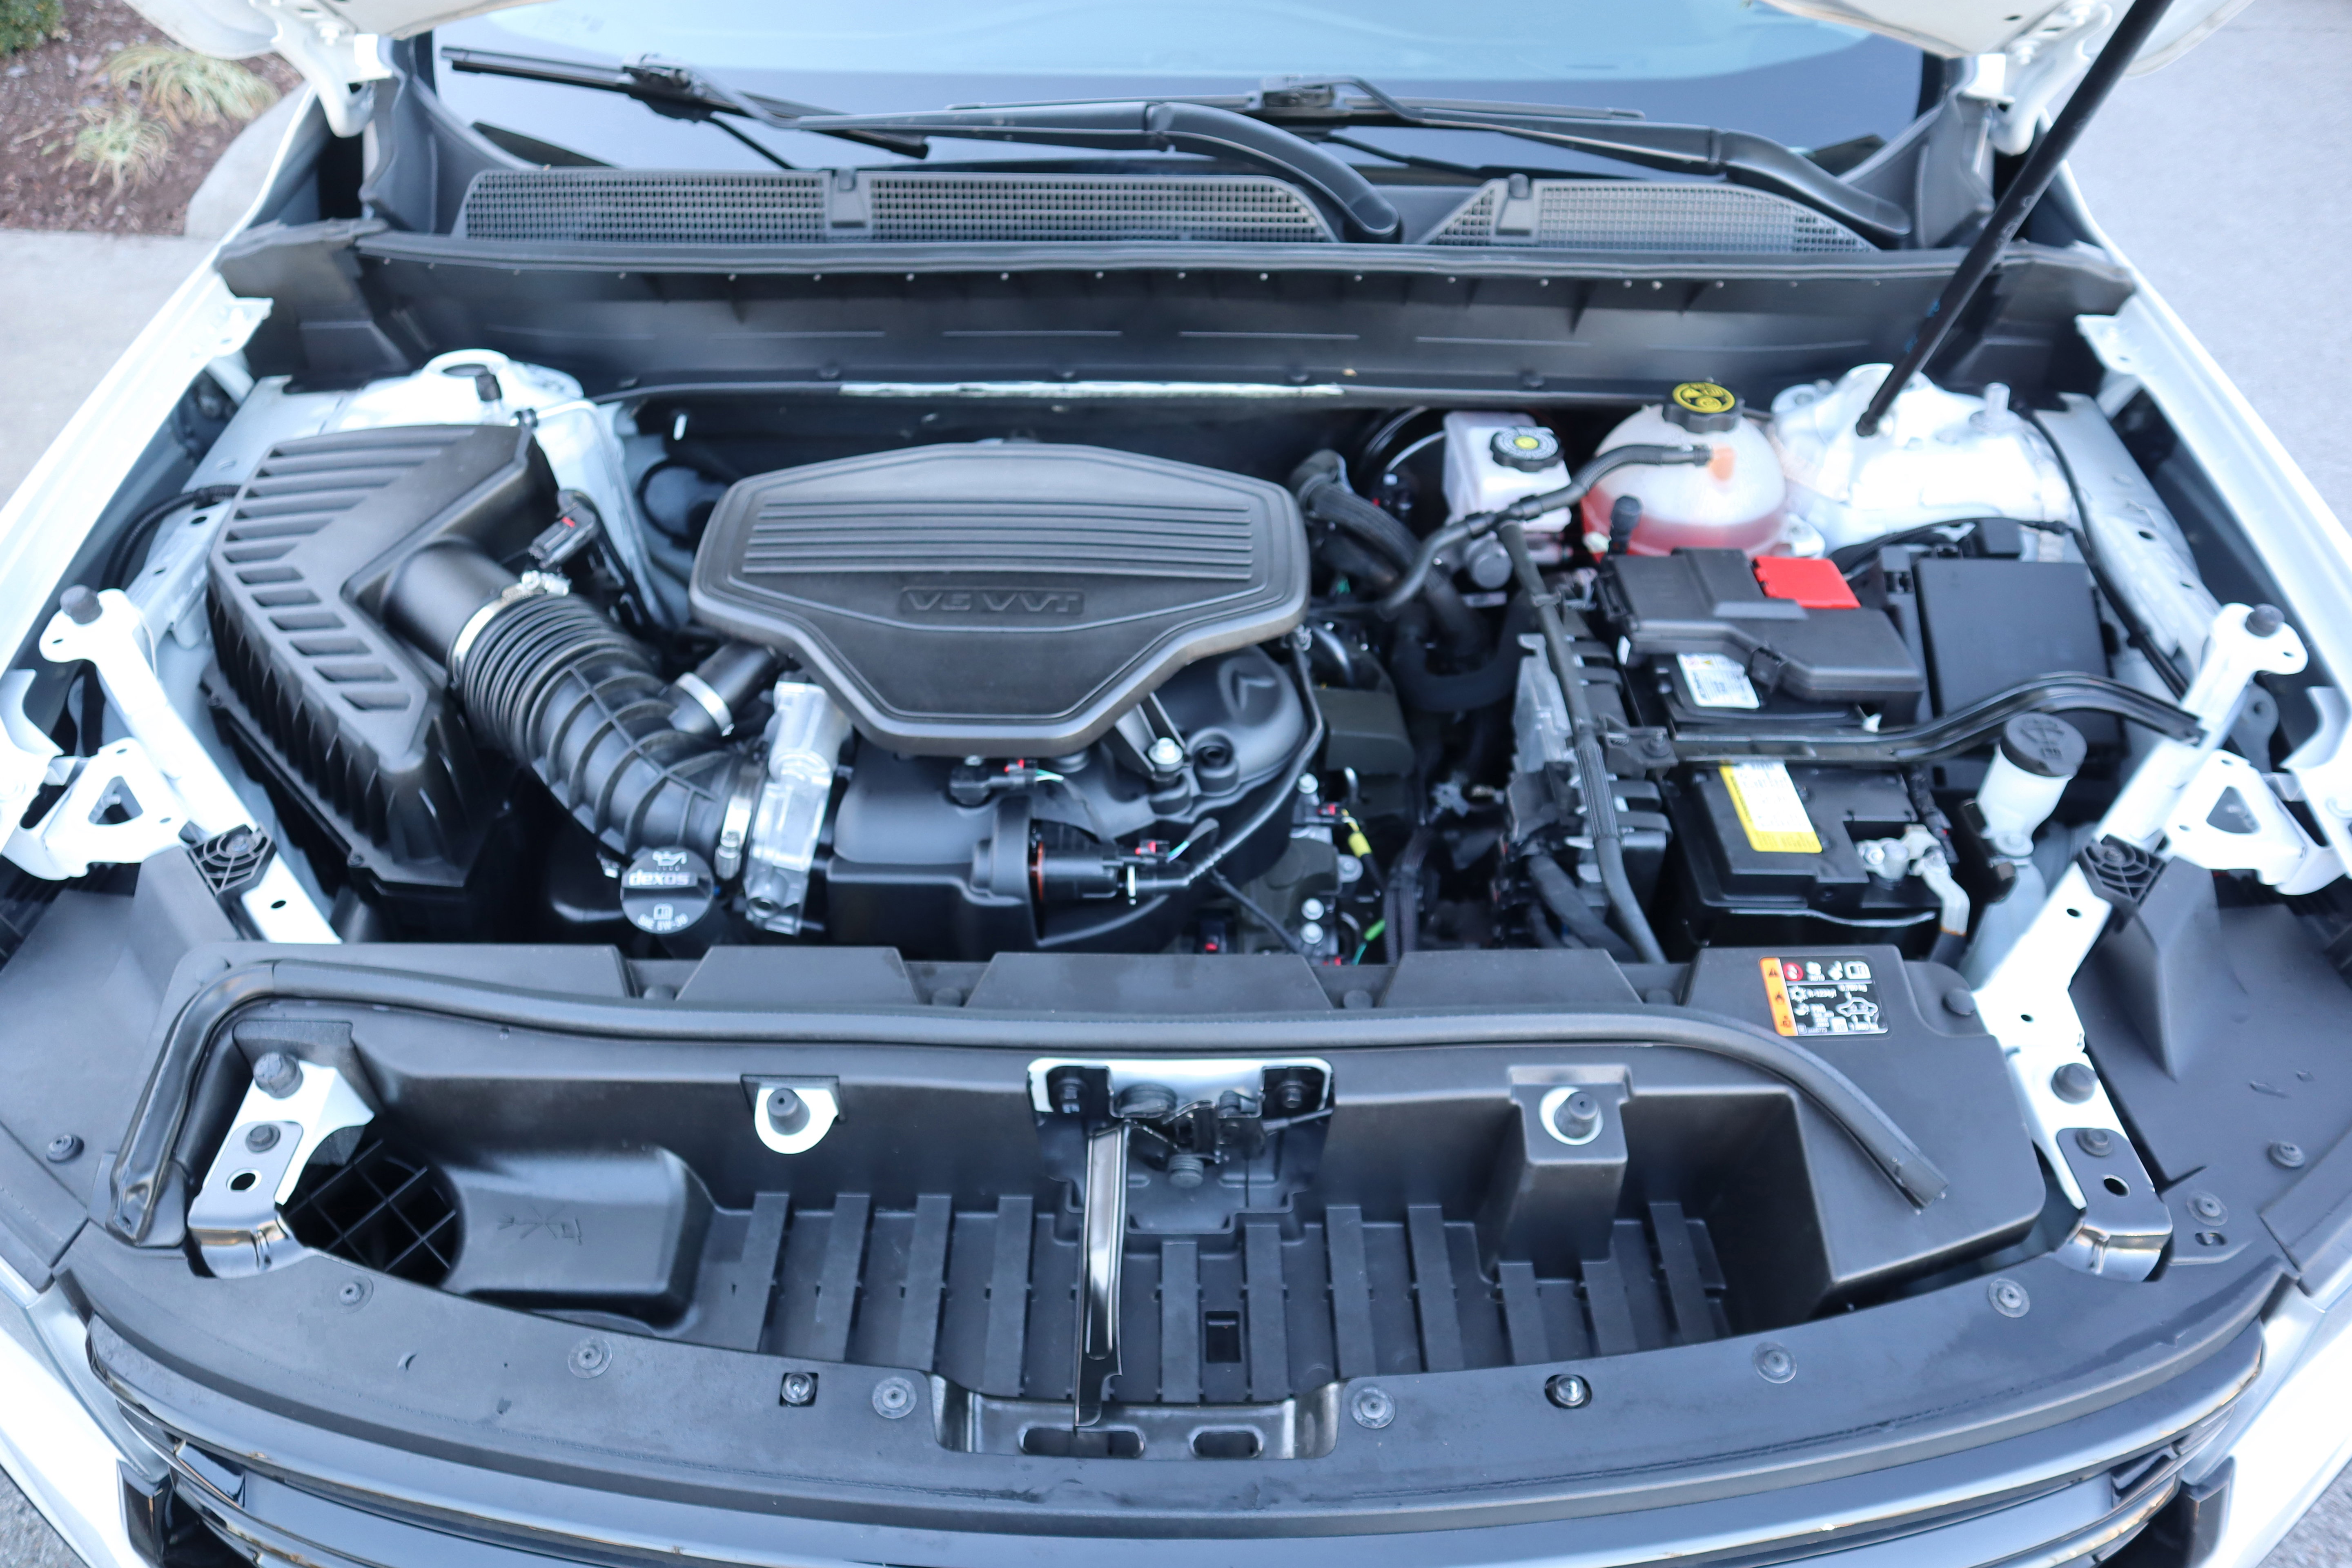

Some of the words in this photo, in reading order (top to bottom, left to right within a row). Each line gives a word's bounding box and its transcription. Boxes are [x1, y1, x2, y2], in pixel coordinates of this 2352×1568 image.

[907, 592, 971, 611] V6
[982, 592, 1079, 612] VVT
[628, 869, 690, 886] dexos
